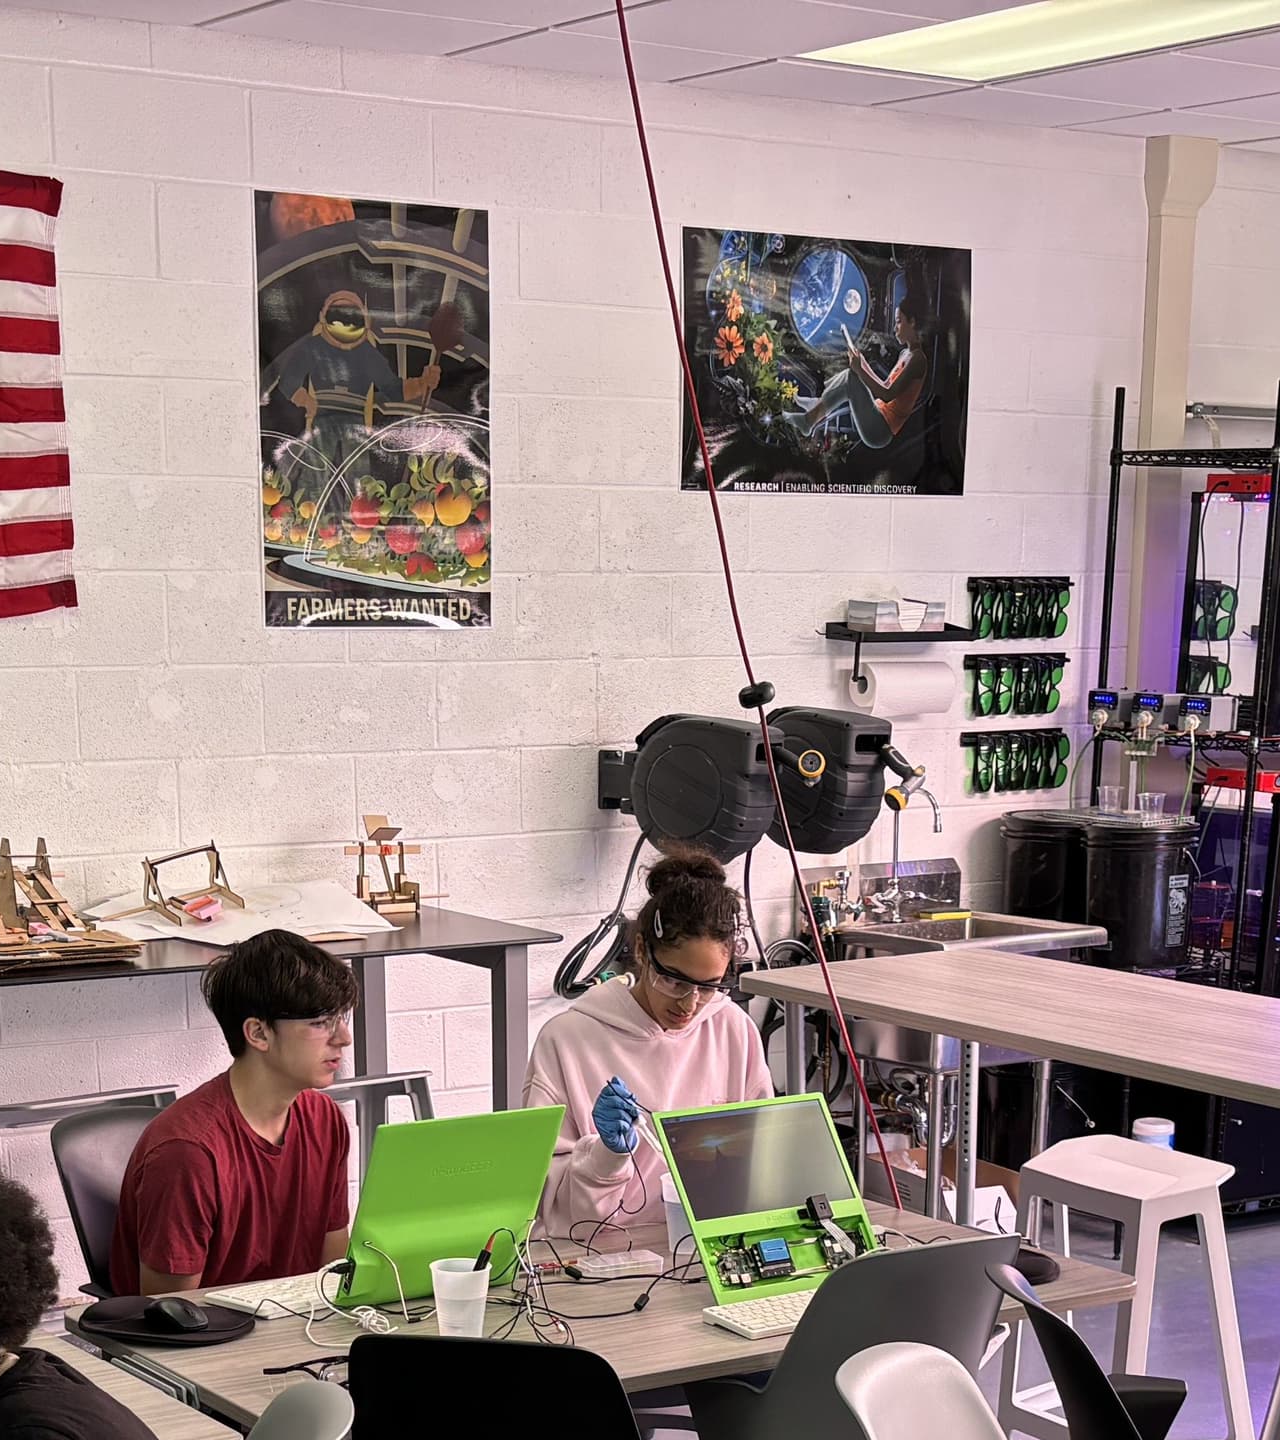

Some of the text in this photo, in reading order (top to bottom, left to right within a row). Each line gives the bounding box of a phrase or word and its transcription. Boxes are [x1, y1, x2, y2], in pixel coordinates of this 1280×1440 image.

[734, 481, 918, 495] RESEARCH ENABLING SCIENTIFIC DISCOVERY
[286, 596, 471, 622] FARMERS WANTED
